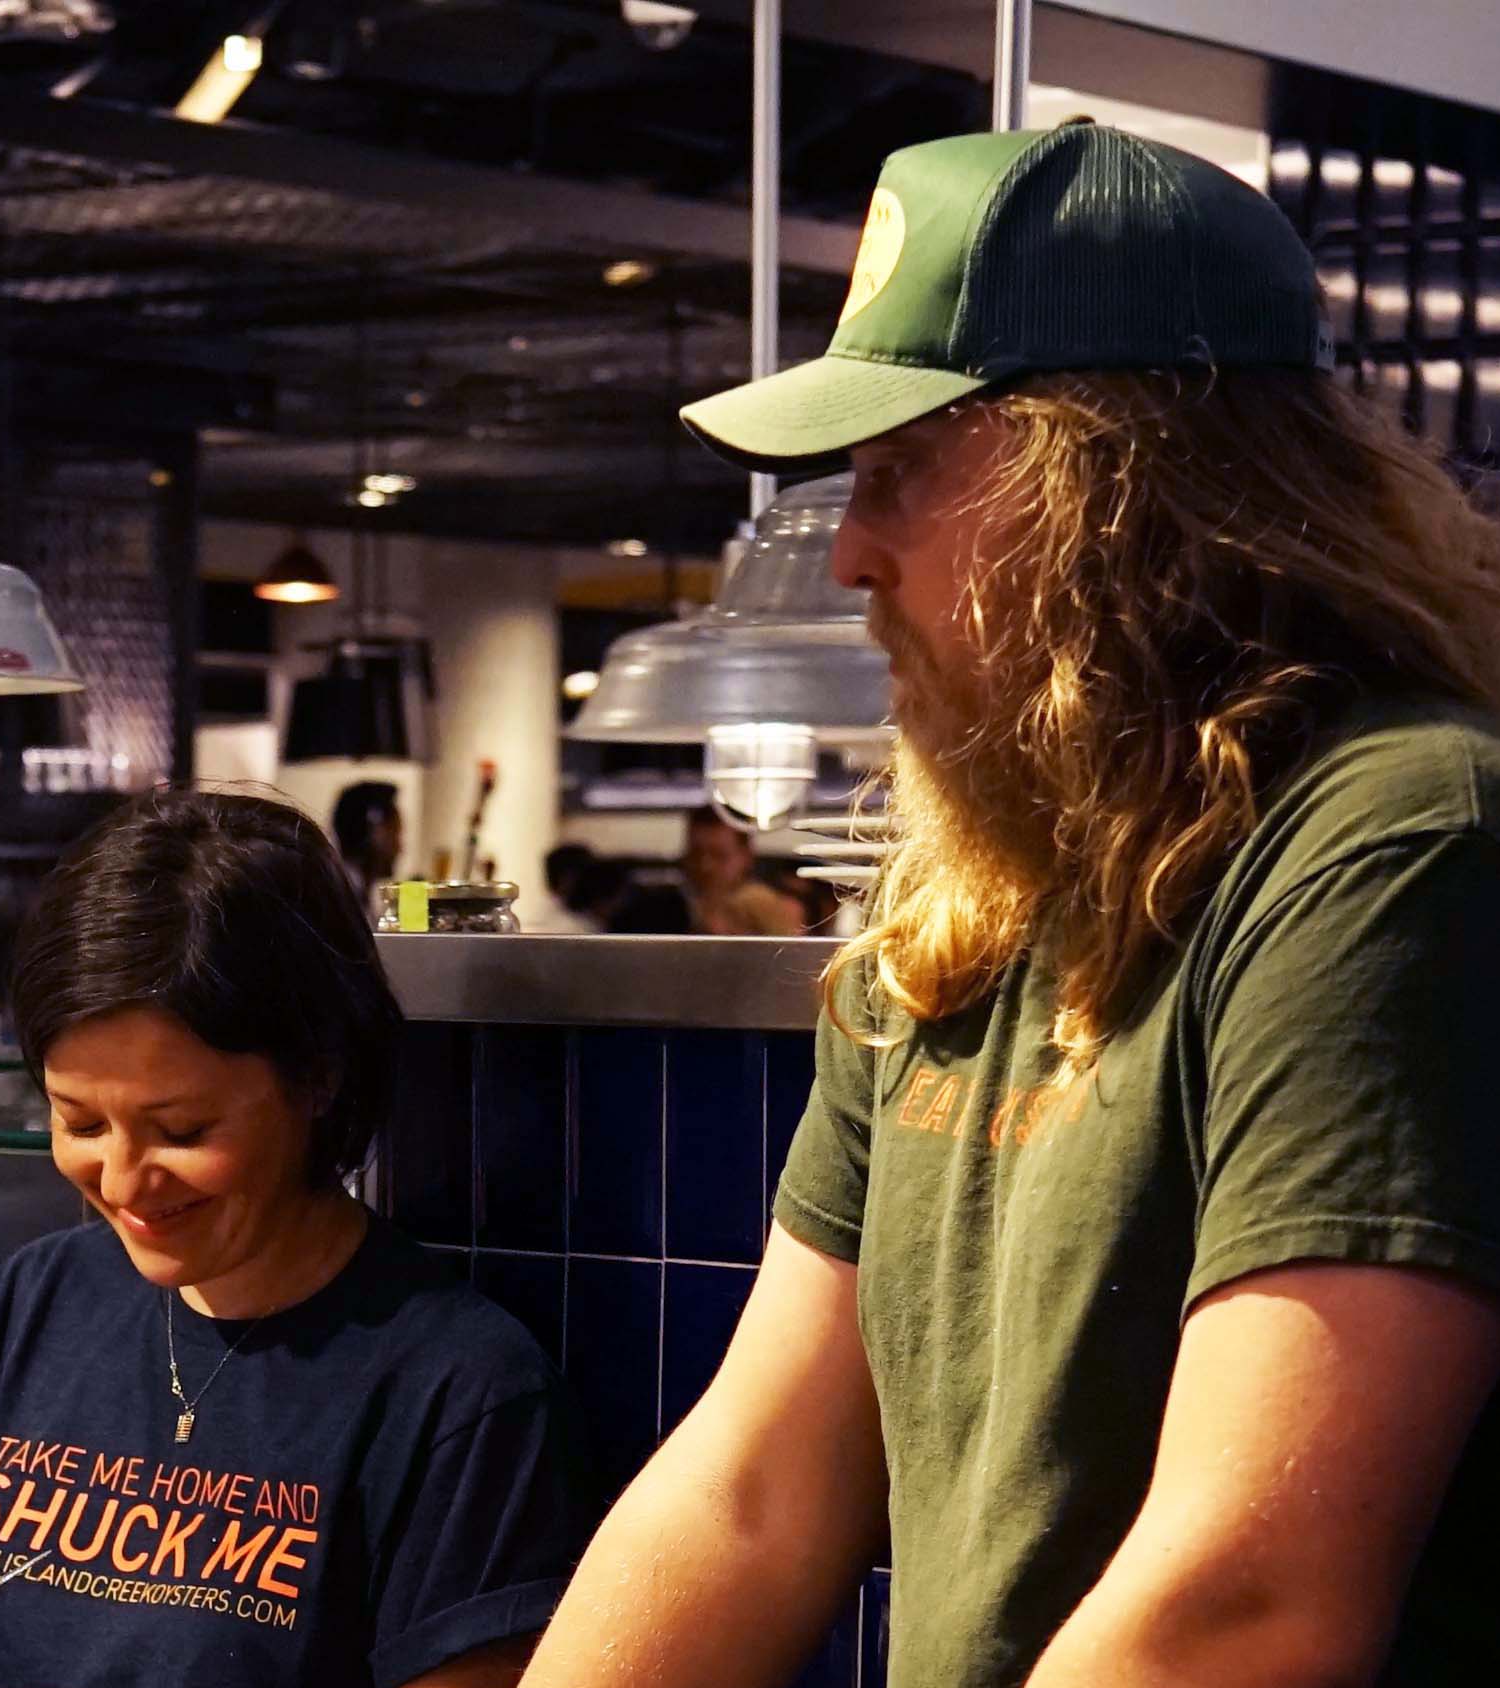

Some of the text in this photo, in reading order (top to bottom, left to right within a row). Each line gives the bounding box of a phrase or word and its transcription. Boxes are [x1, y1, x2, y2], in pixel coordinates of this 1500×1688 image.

[88, 1451, 146, 1497] ME
[149, 1463, 256, 1516] HOME
[253, 1479, 321, 1526] AND
[200, 1519, 320, 1600] ME
